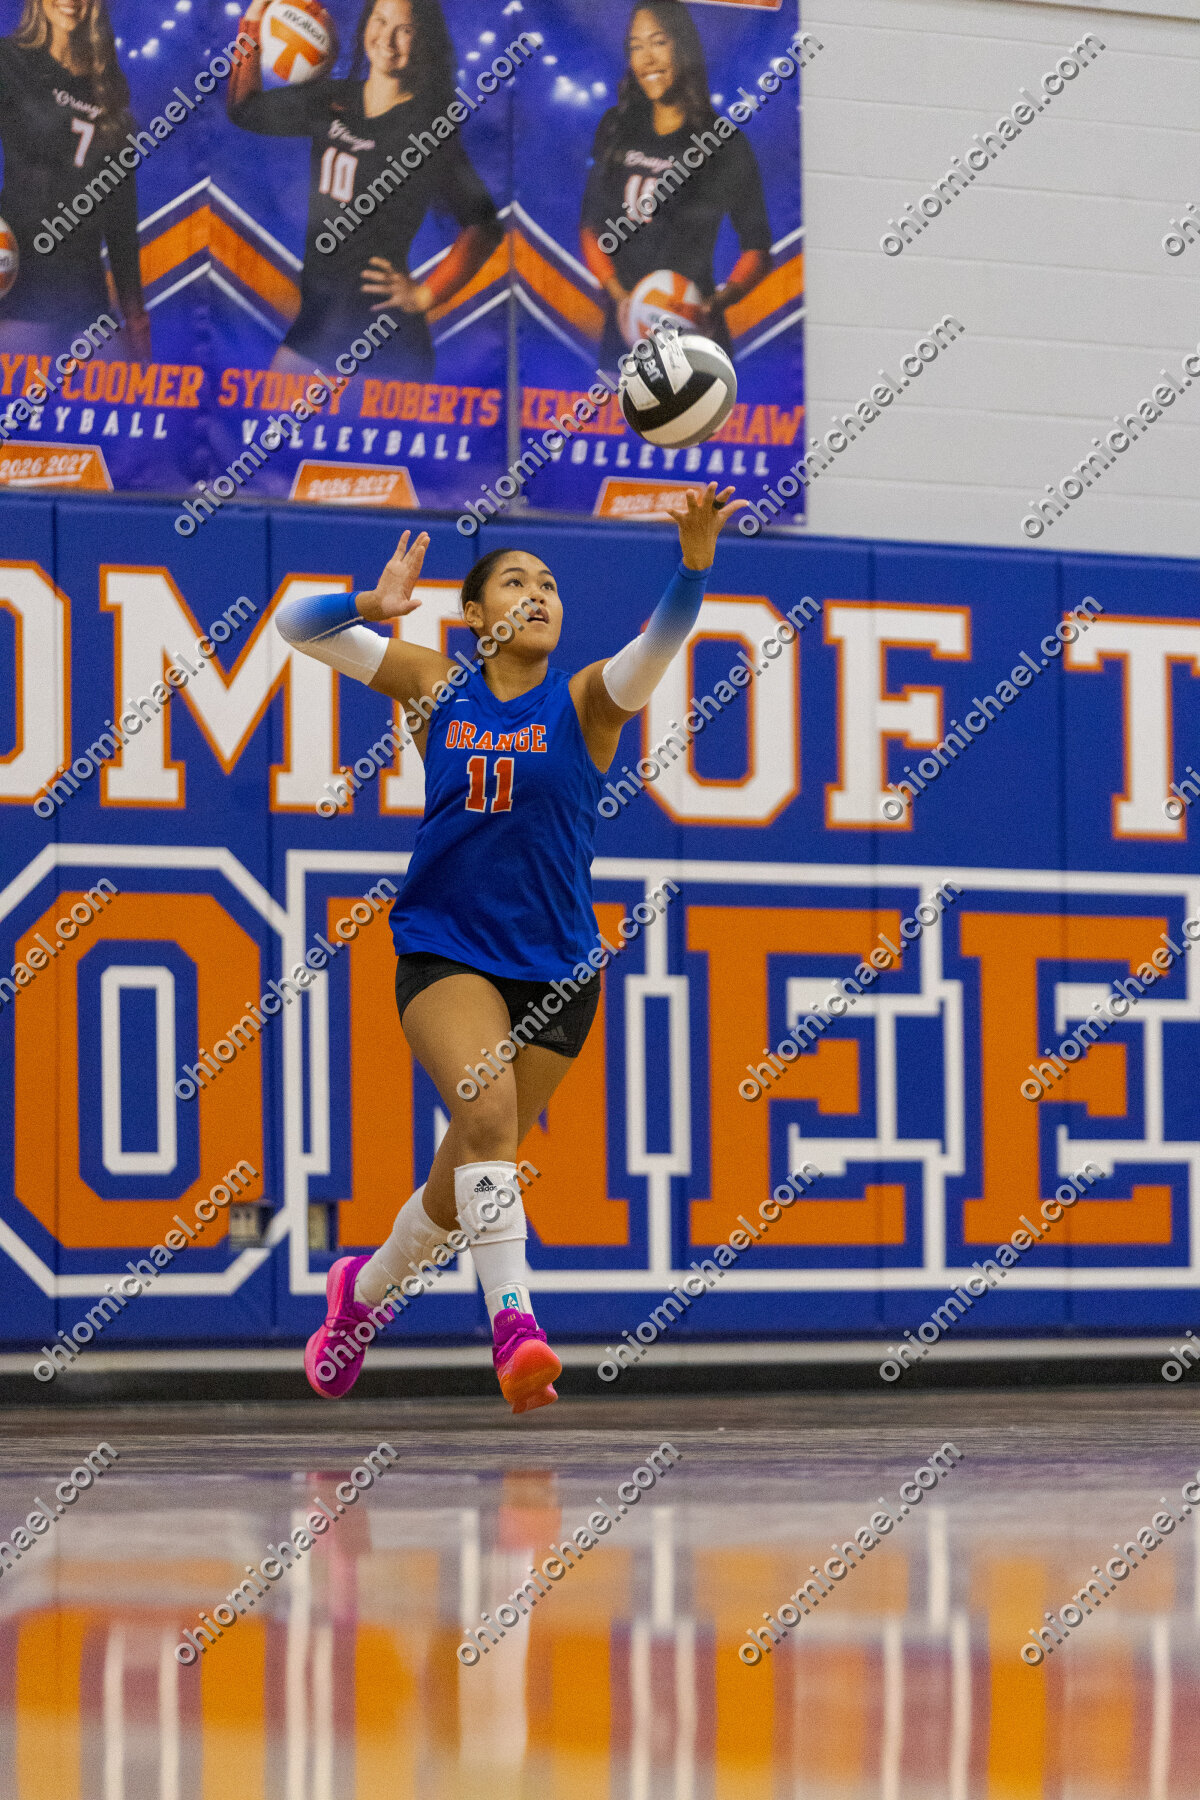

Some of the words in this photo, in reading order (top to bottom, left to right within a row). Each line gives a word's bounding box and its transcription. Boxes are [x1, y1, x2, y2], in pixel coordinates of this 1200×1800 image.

[71, 117, 96, 168] 7
[318, 146, 359, 204] 10
[61, 358, 206, 409] COOMER
[218, 367, 350, 415] SYDNEY
[359, 379, 502, 427] ROBERTS
[445, 720, 548, 752] ORANGE
[641, 593, 972, 832] OF
[465, 755, 515, 813] 11
[474, 1183, 498, 1193] adidas
